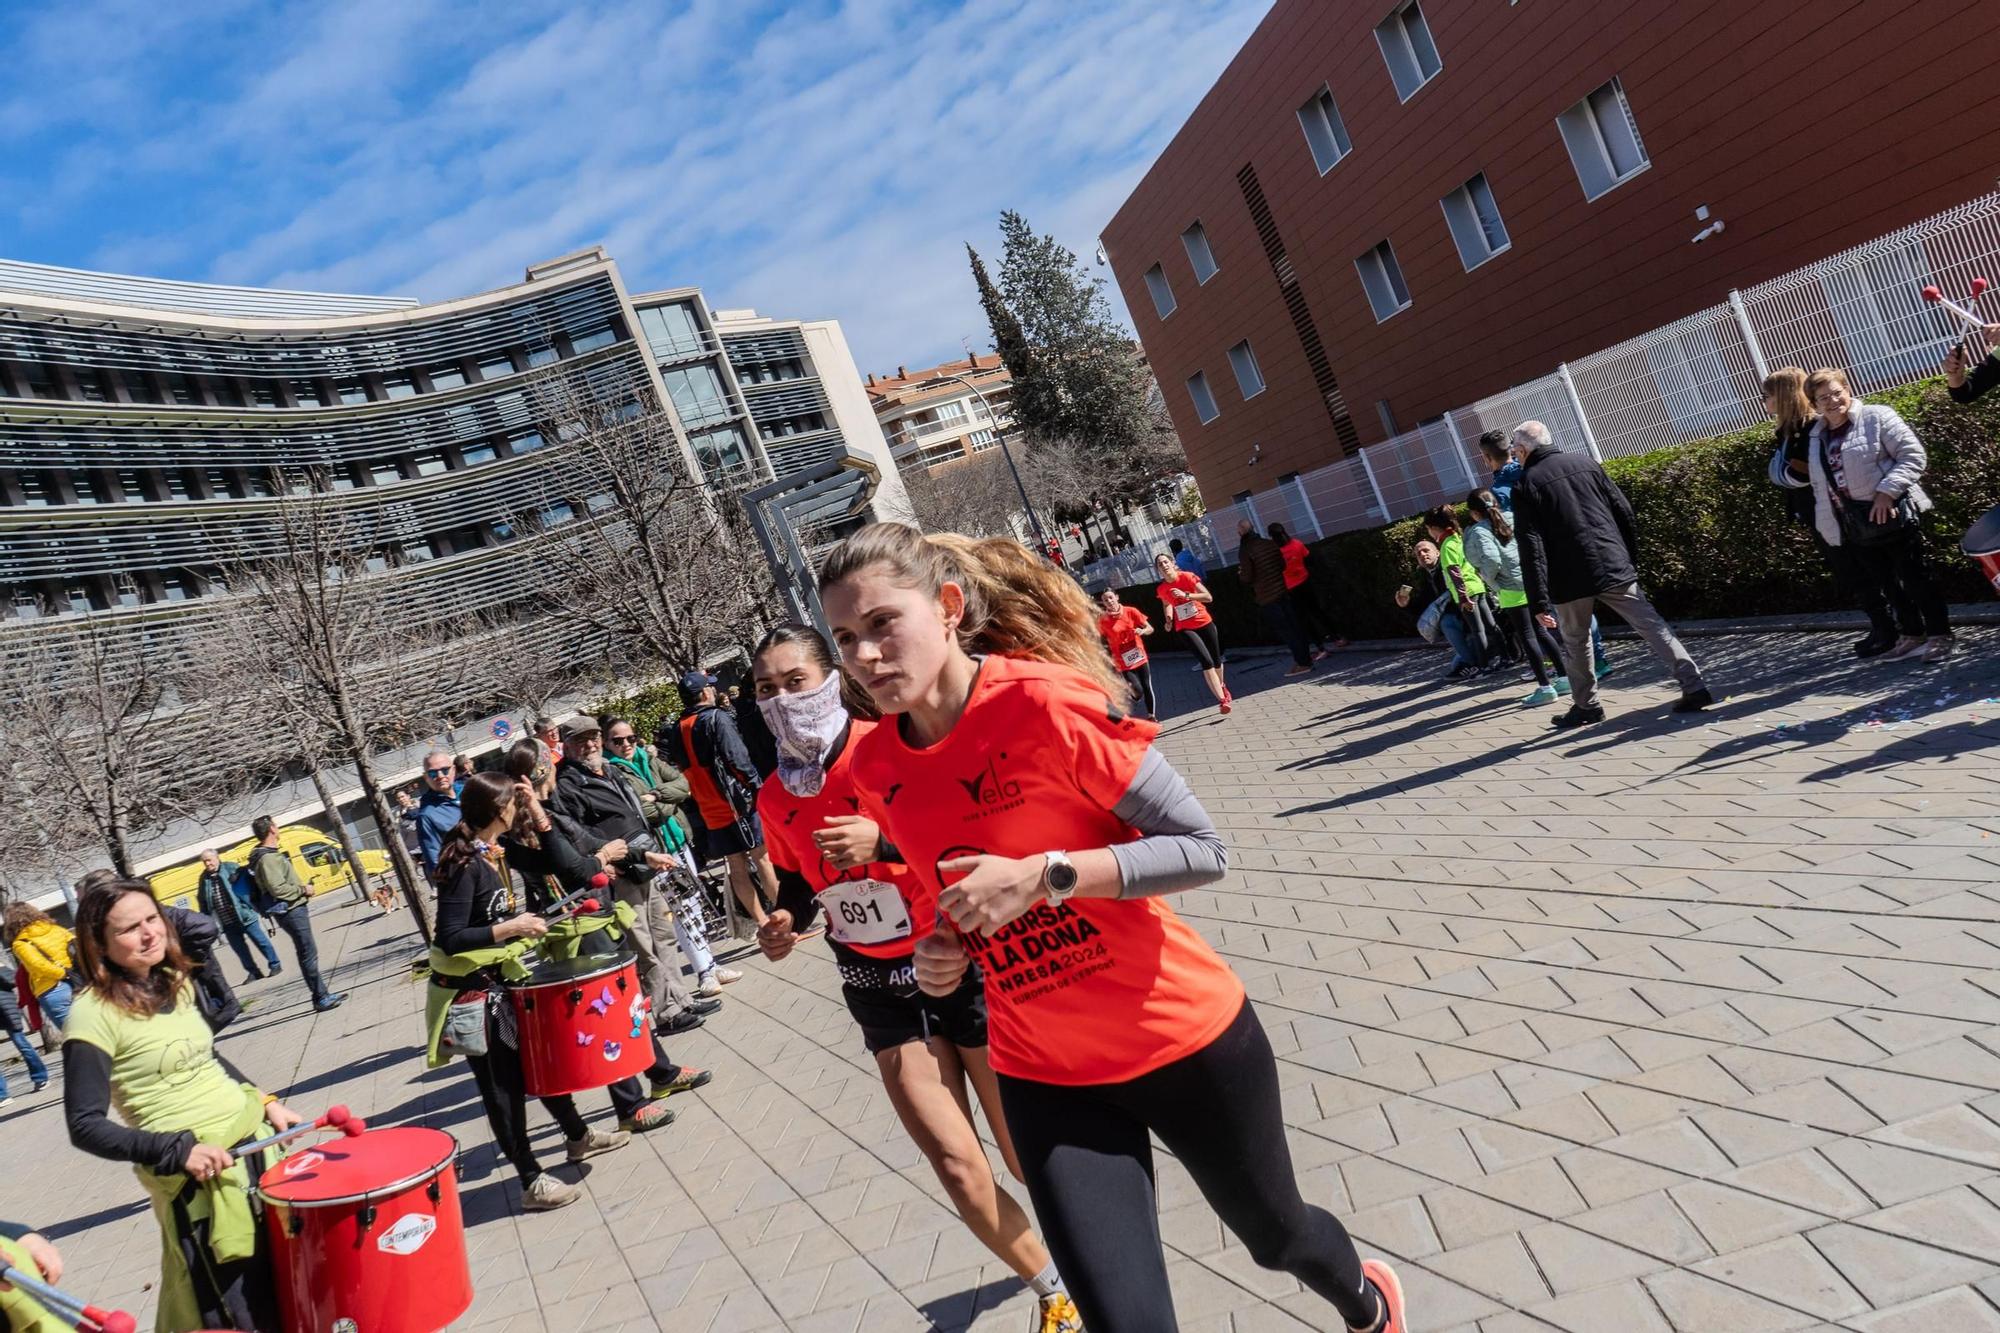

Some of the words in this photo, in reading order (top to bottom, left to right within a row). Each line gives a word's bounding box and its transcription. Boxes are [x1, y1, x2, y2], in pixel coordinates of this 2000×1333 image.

[840, 899, 883, 924] 691
[992, 901, 1079, 943] CURSA
[986, 944, 1026, 974] LA
[1020, 917, 1102, 961] DONA
[1060, 941, 1109, 969] 2024
[1011, 983, 1056, 1006] EUROPEA
[1056, 978, 1070, 990] DE
